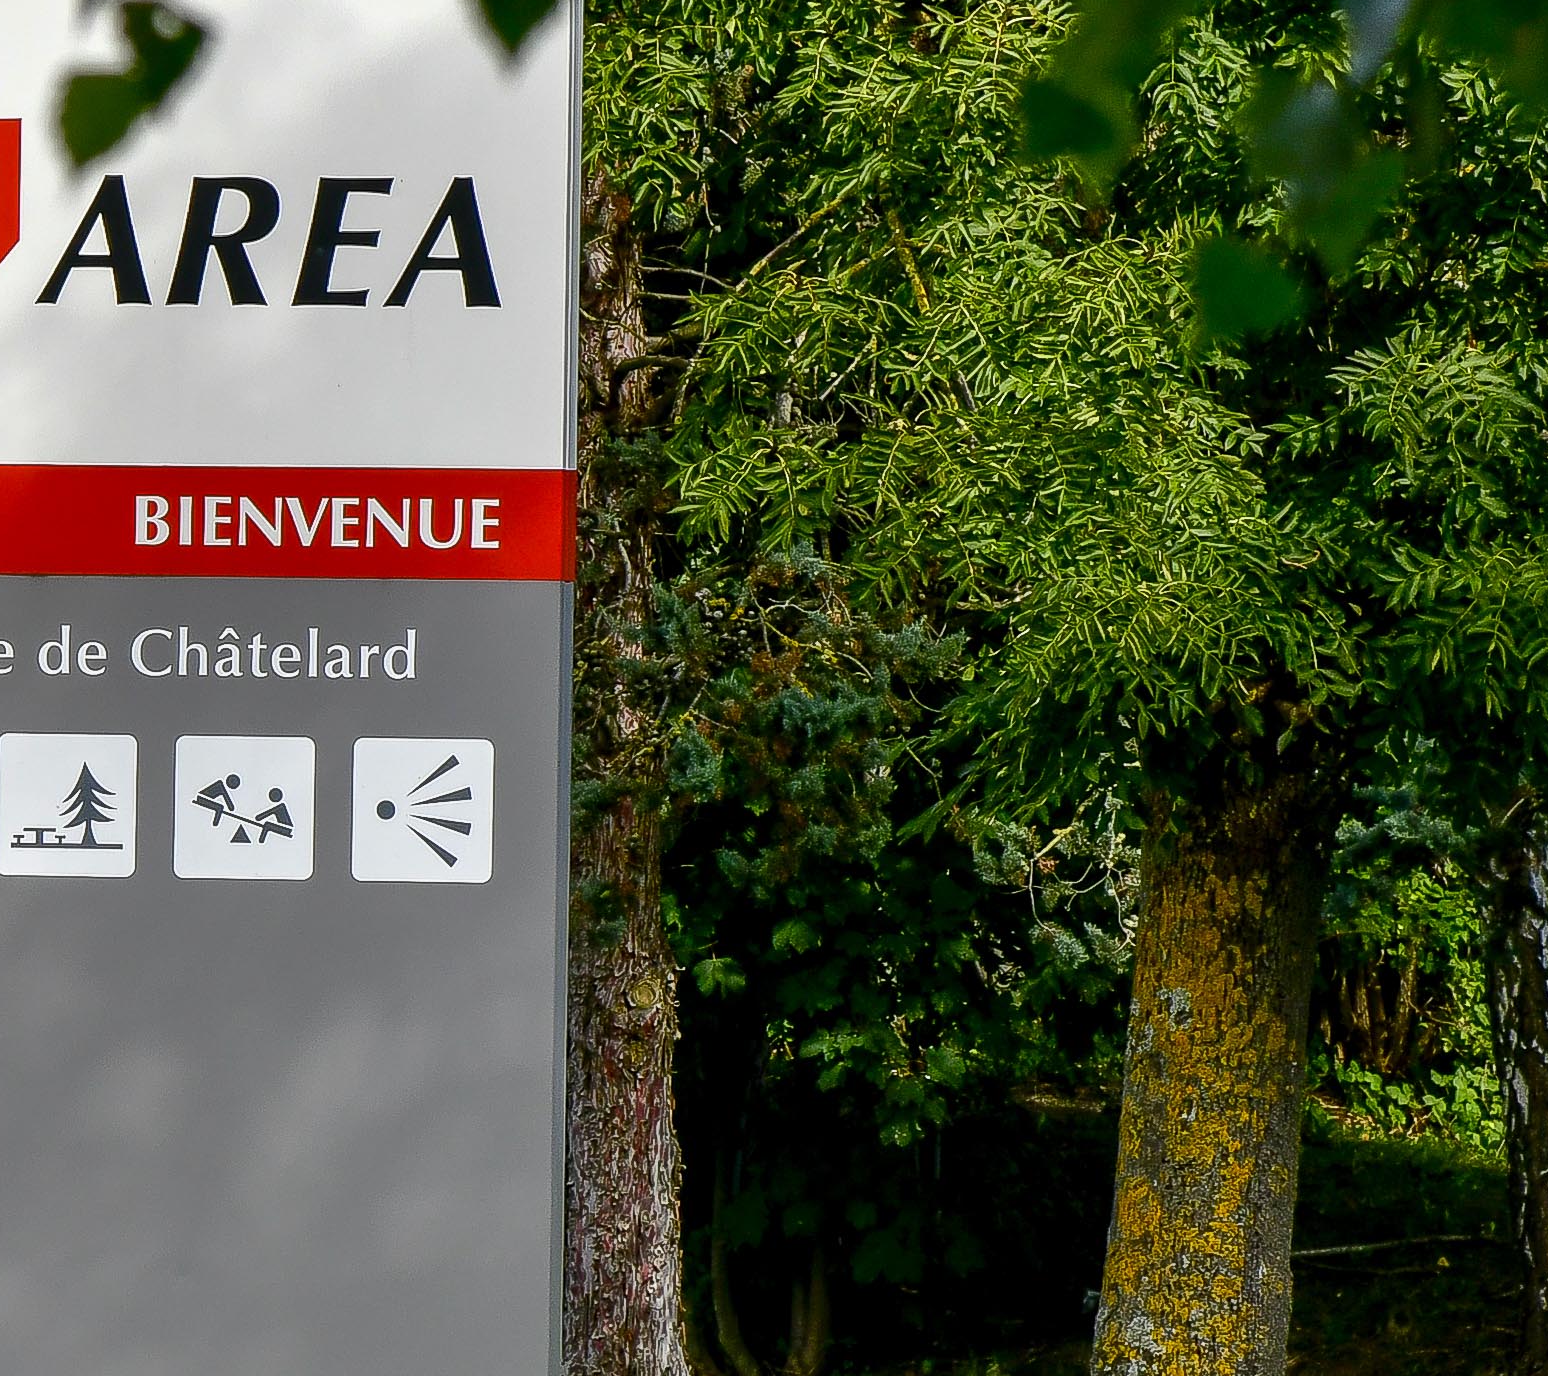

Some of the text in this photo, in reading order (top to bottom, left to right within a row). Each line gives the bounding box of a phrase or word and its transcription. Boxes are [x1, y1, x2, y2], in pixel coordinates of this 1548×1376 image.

[35, 173, 502, 309] AREA
[134, 494, 501, 550] BIENVENUE
[37, 623, 107, 677] de
[130, 625, 417, 681] Châtelard
